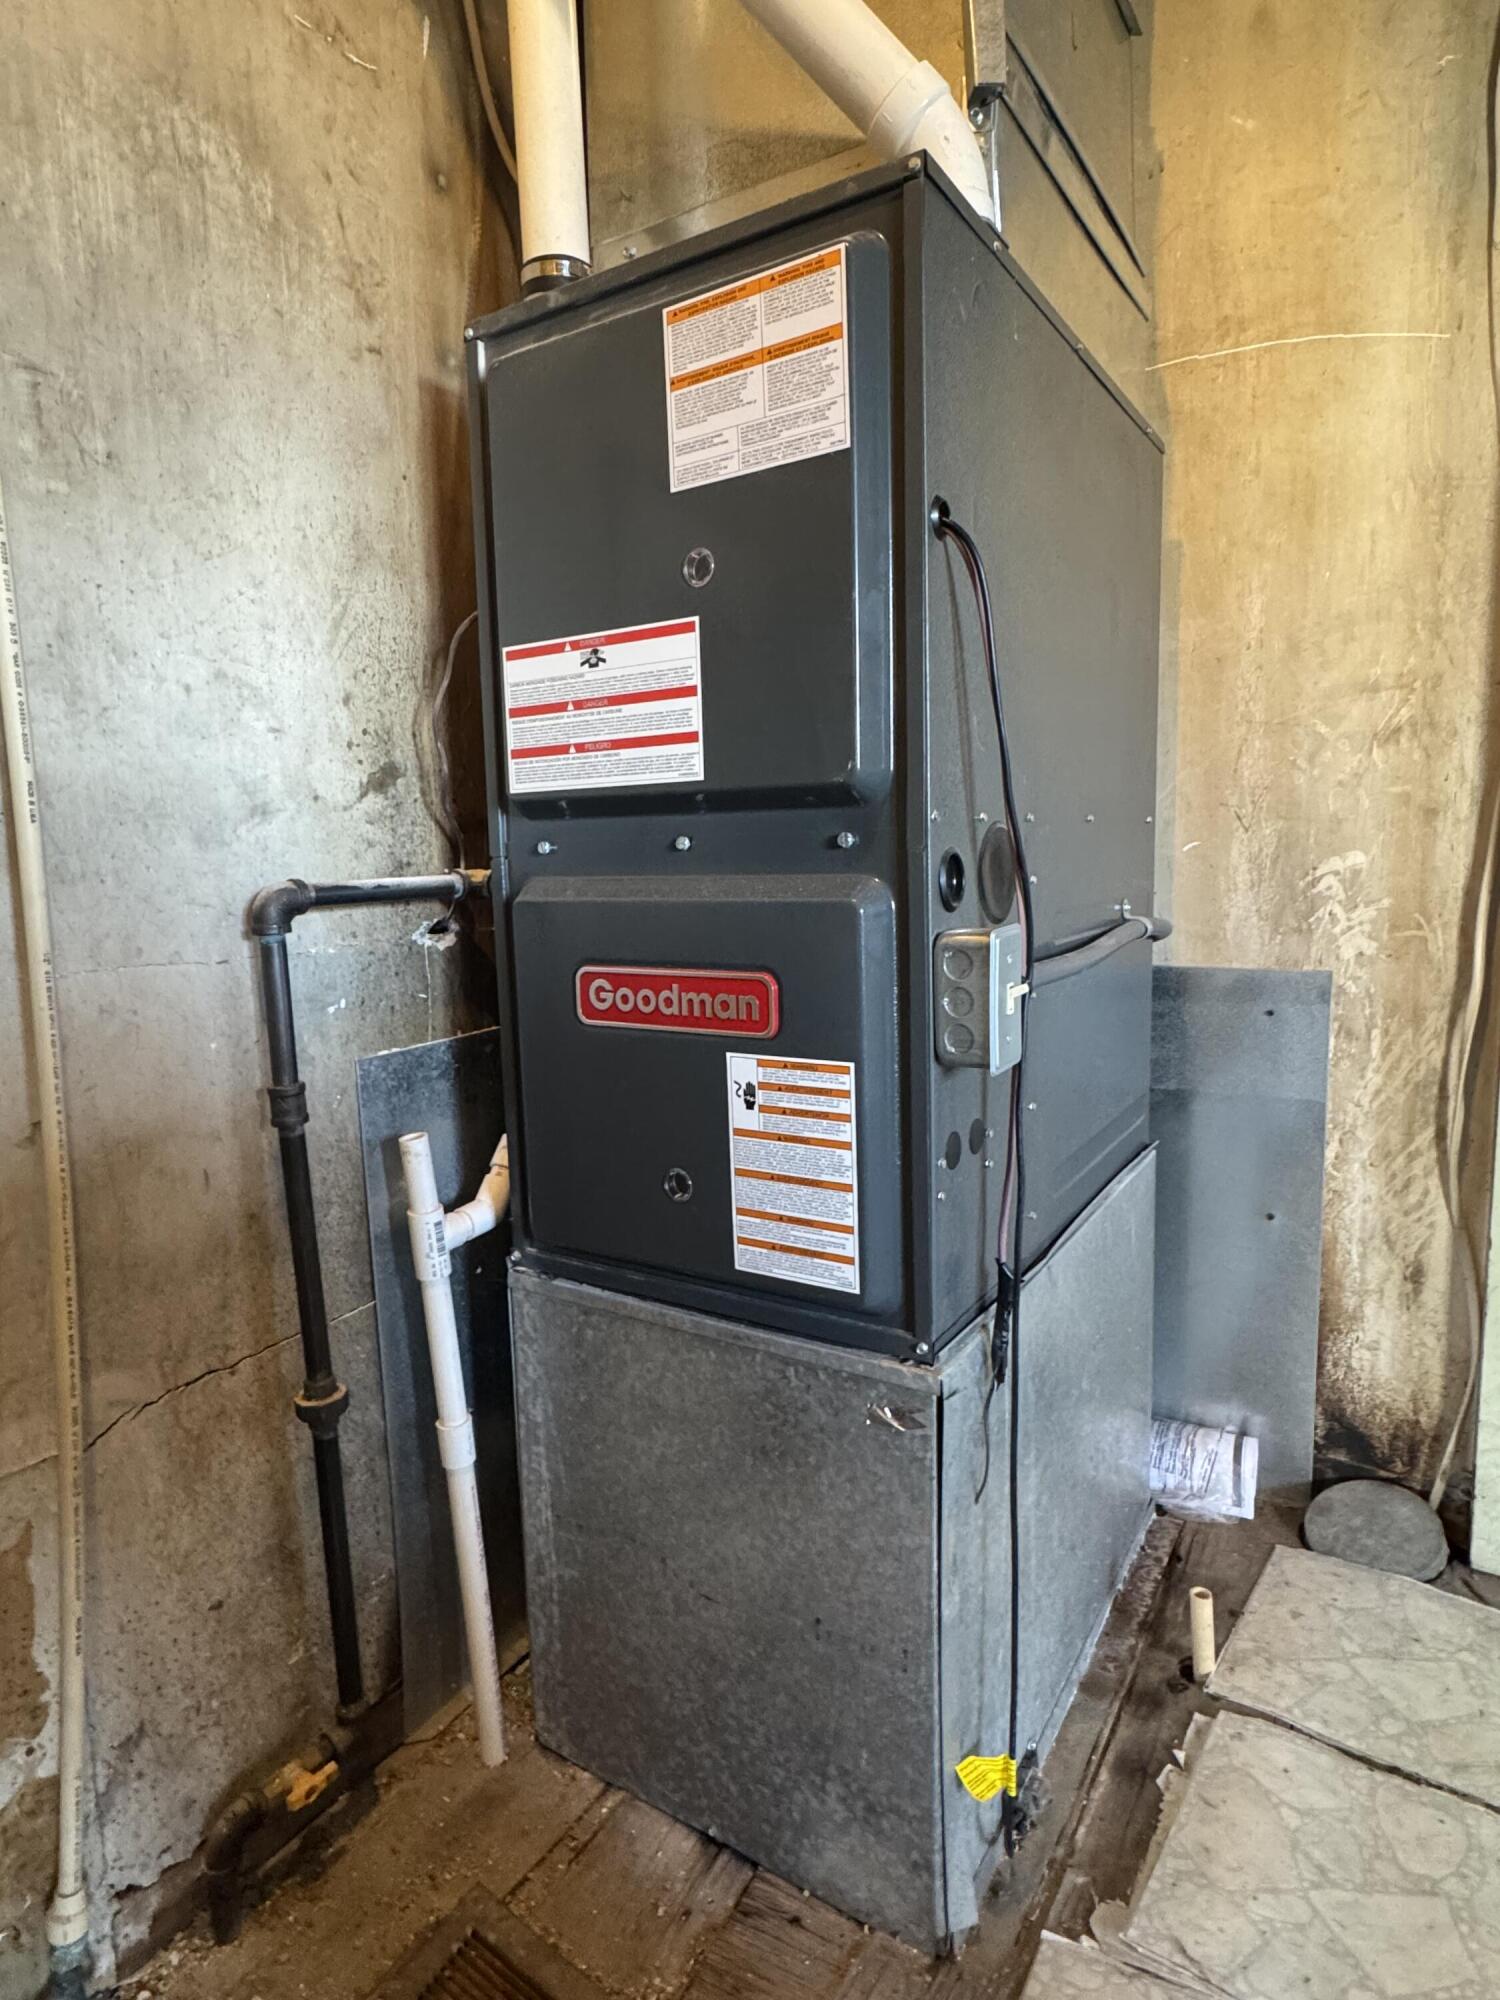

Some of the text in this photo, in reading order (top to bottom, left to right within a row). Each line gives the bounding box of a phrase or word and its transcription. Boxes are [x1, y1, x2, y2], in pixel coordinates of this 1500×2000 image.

[579, 637, 606, 647] DANGER
[582, 698, 609, 709] DANGER
[585, 741, 612, 752] PELIGRO
[588, 978, 761, 1022] Goodman
